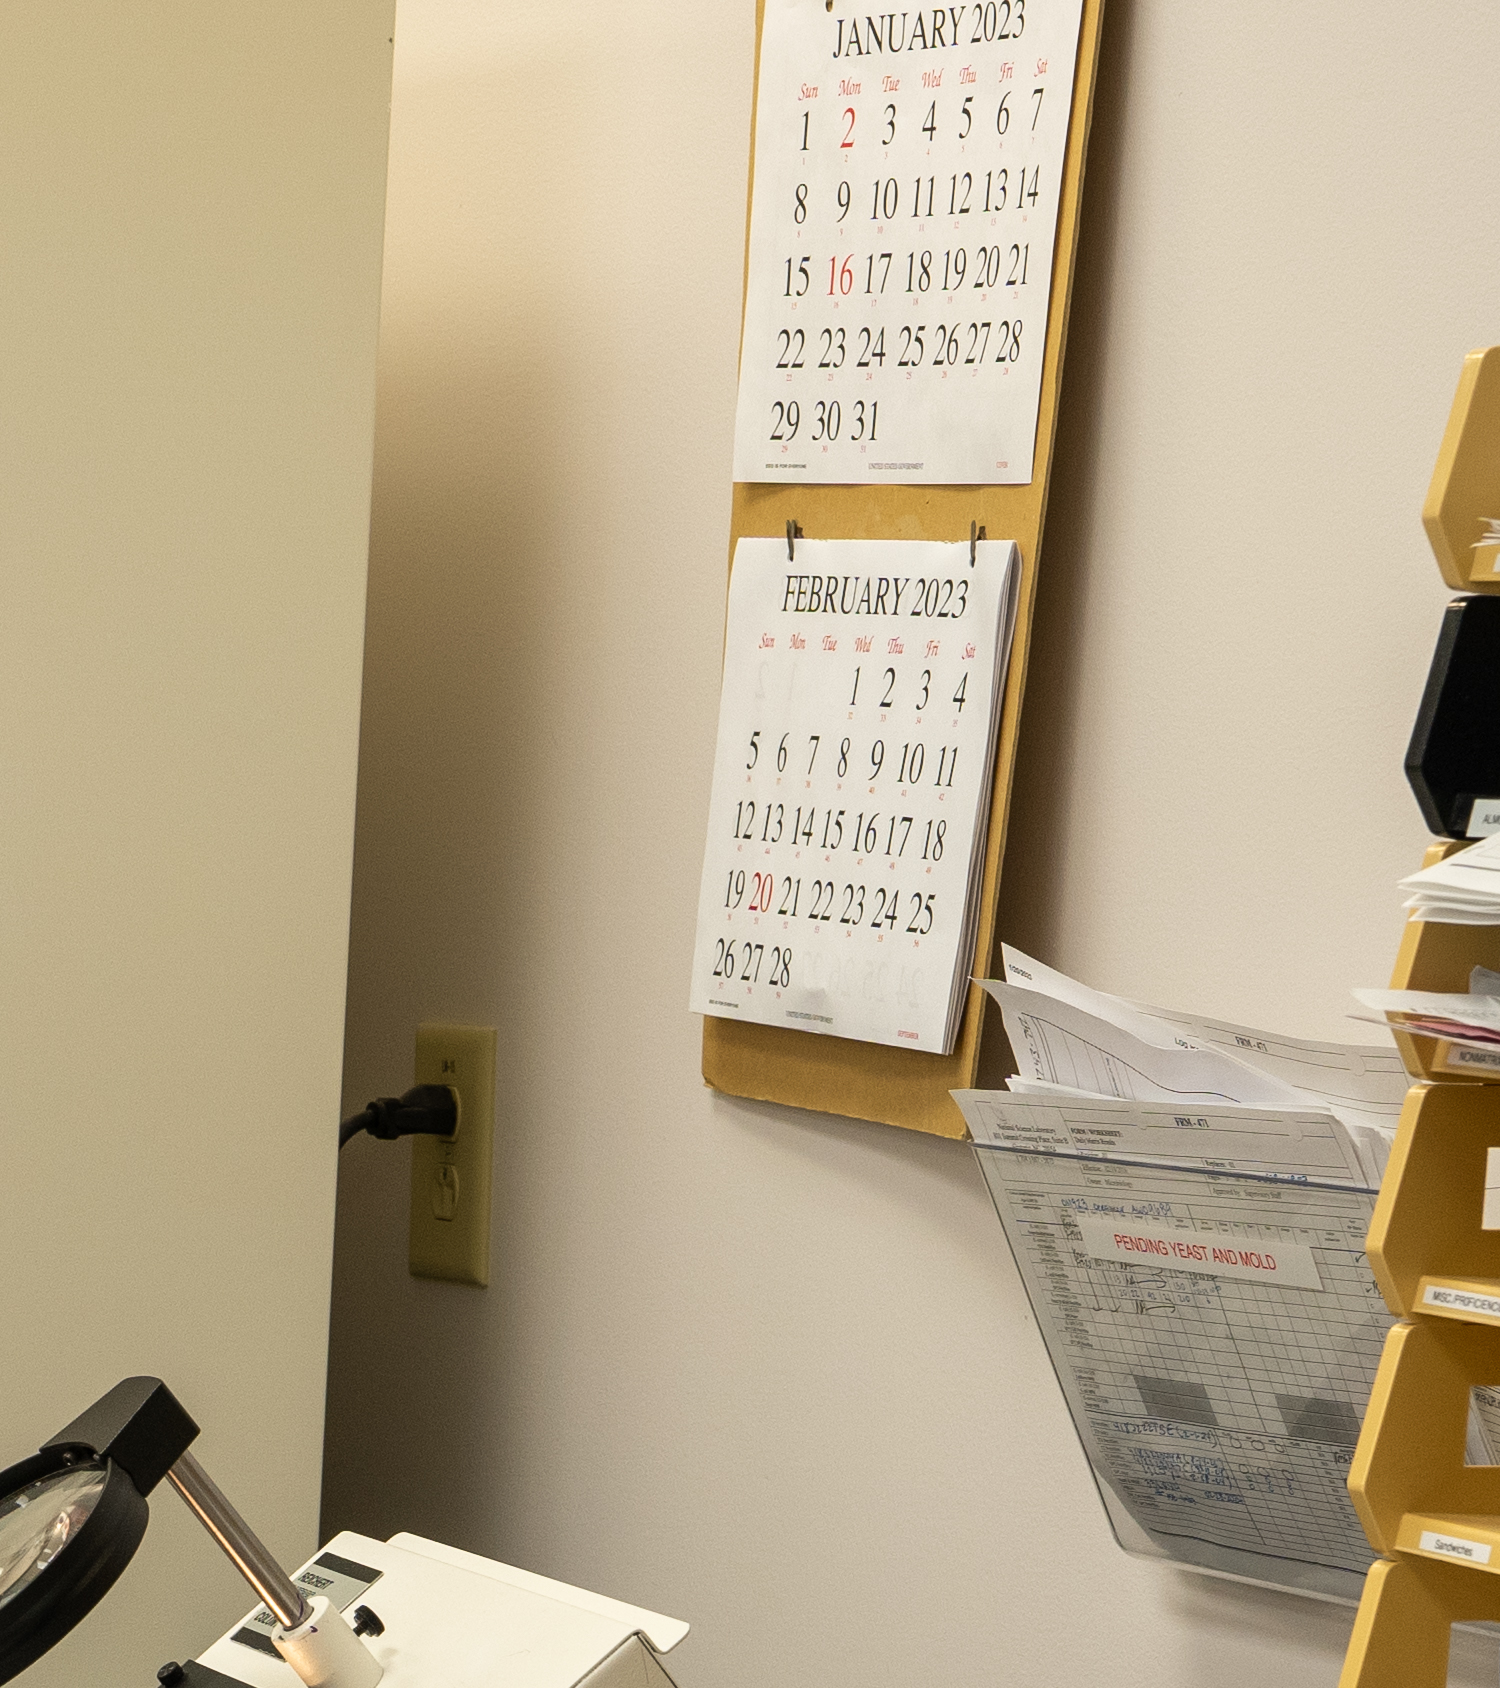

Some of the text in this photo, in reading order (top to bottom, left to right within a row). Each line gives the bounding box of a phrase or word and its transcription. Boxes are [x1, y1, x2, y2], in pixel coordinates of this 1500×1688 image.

[833, 0, 1025, 58] JANUARY 2023
[798, 58, 1047, 101] Sun Mon Tue Wed Thu Fri Sat
[801, 88, 1044, 150] 1 2 3 4 5 6 7
[794, 165, 1039, 224] 8 9 10 11 12 13 14
[784, 244, 1028, 296] 15 16 17 18 19 20 21
[776, 319, 1023, 368] 22 23 24 25 26 27 28
[770, 400, 877, 441] 29 30 31
[782, 575, 968, 619] FEBRUARY 2023
[759, 633, 975, 660] Sun Mon Tue Wed Thu Fri Sat
[850, 667, 968, 712] 1 2 3 4
[747, 731, 957, 787] 5 6 7 8 9 10 11
[734, 801, 947, 861] 12 13 14 15 16 17 18
[724, 870, 935, 934] 19 20 21 22 23 24 25
[713, 938, 792, 988] 26 27 28
[1114, 1234, 1277, 1272] PENDING YEAST AND MOLD
